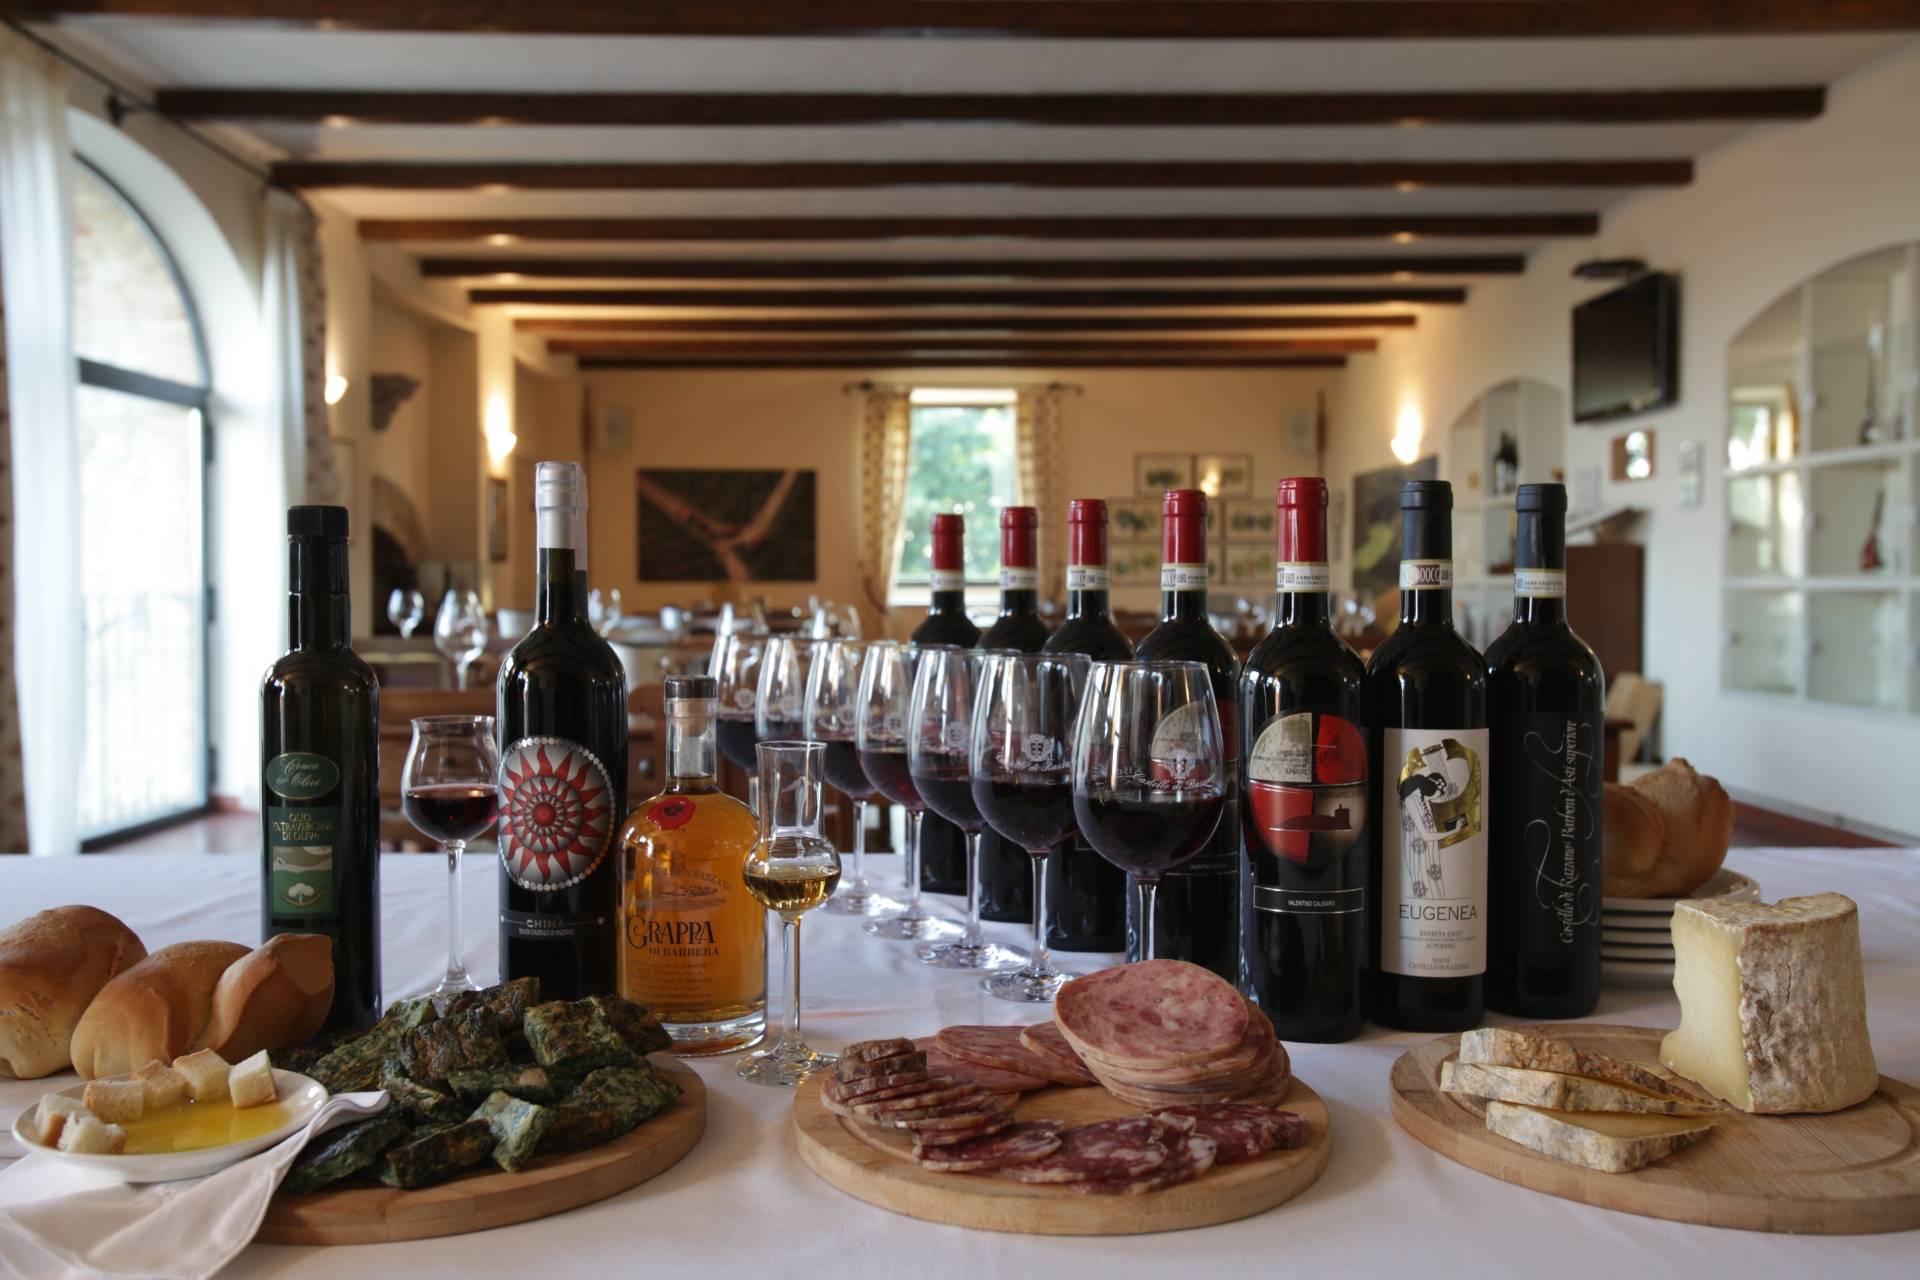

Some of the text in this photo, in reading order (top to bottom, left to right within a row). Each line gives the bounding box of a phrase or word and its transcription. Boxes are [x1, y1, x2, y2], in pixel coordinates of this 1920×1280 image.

[289, 813, 312, 822] OLIO
[1399, 904, 1478, 921] EUGENEA
[627, 914, 717, 949] GRAPPA
[663, 947, 720, 957] BARBERA
